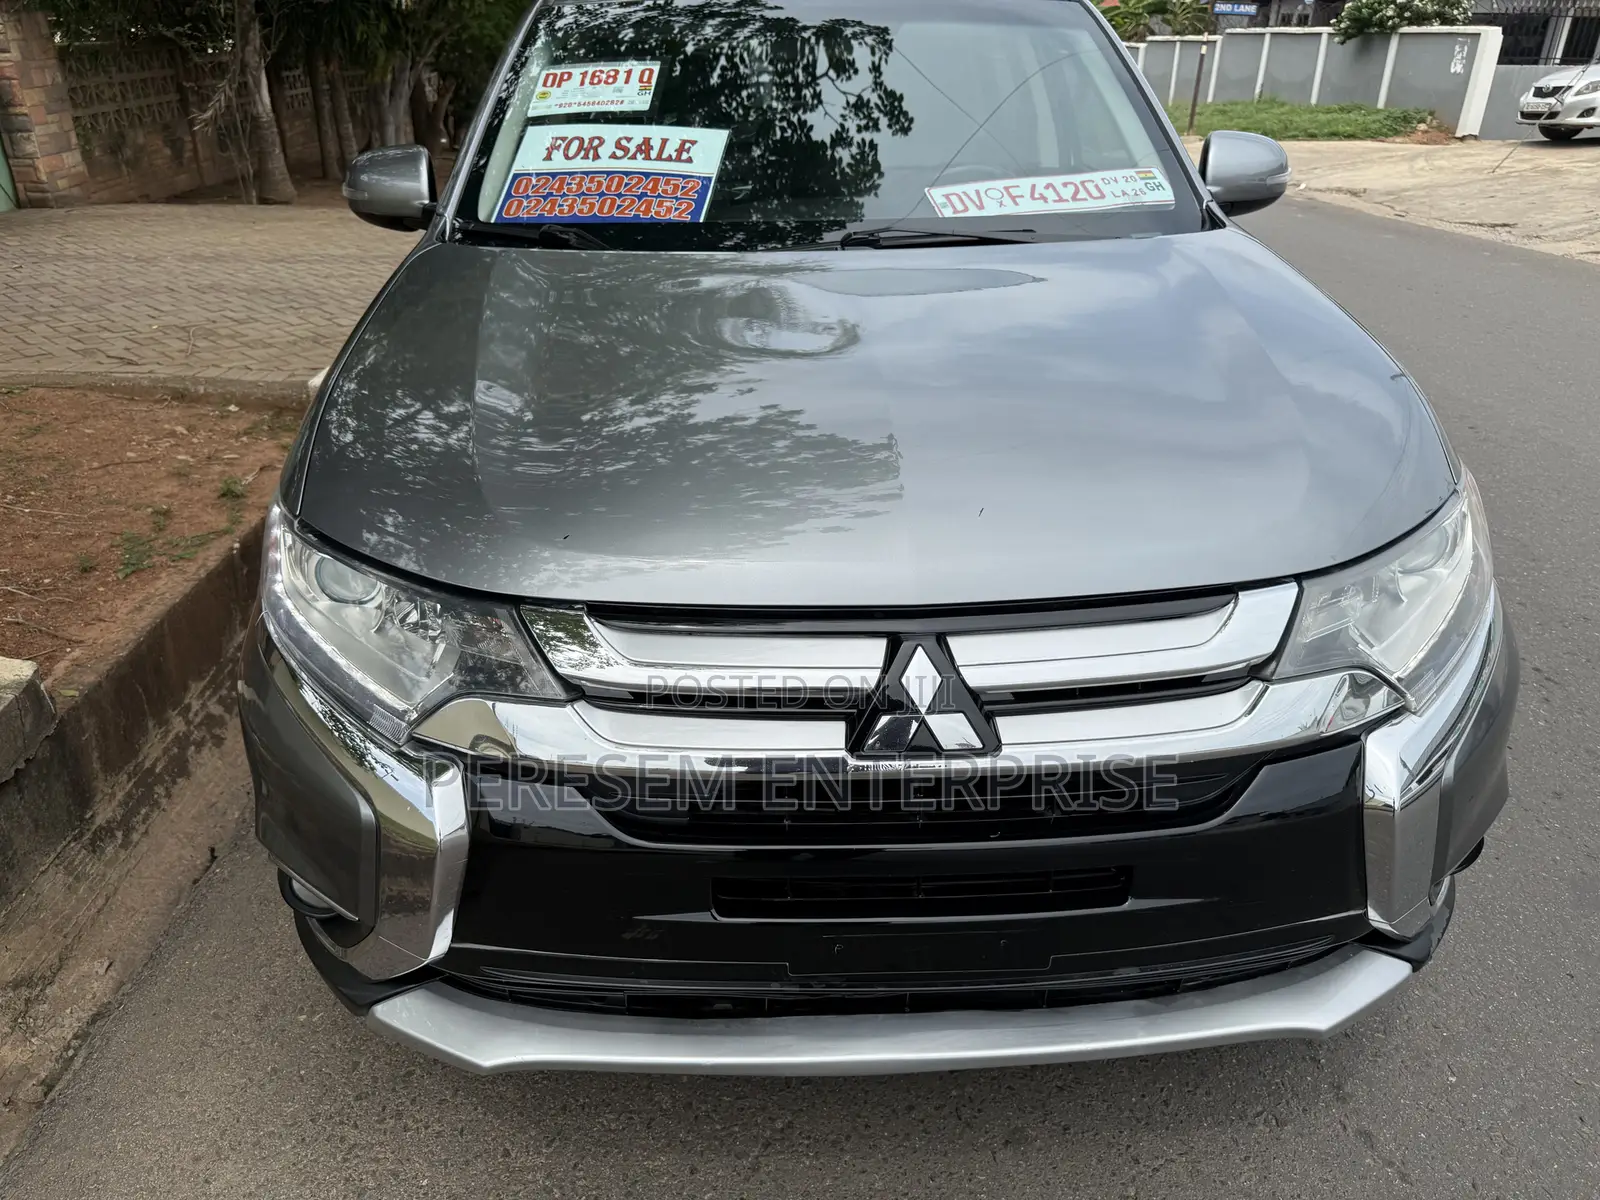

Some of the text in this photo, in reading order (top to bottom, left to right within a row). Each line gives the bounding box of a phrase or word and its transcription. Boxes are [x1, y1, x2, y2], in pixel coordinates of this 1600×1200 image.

[1214, 3, 1257, 13] 2ND LANE
[579, 68, 633, 86] 1681
[638, 67, 655, 84] Q
[542, 136, 698, 164] FOR SALE
[512, 174, 702, 199] 0243502452
[1101, 176, 1119, 185] DV
[1144, 181, 1166, 192] GH
[942, 189, 985, 214] DV
[1110, 187, 1147, 198] LA 26
[503, 196, 696, 221] 0243502452
